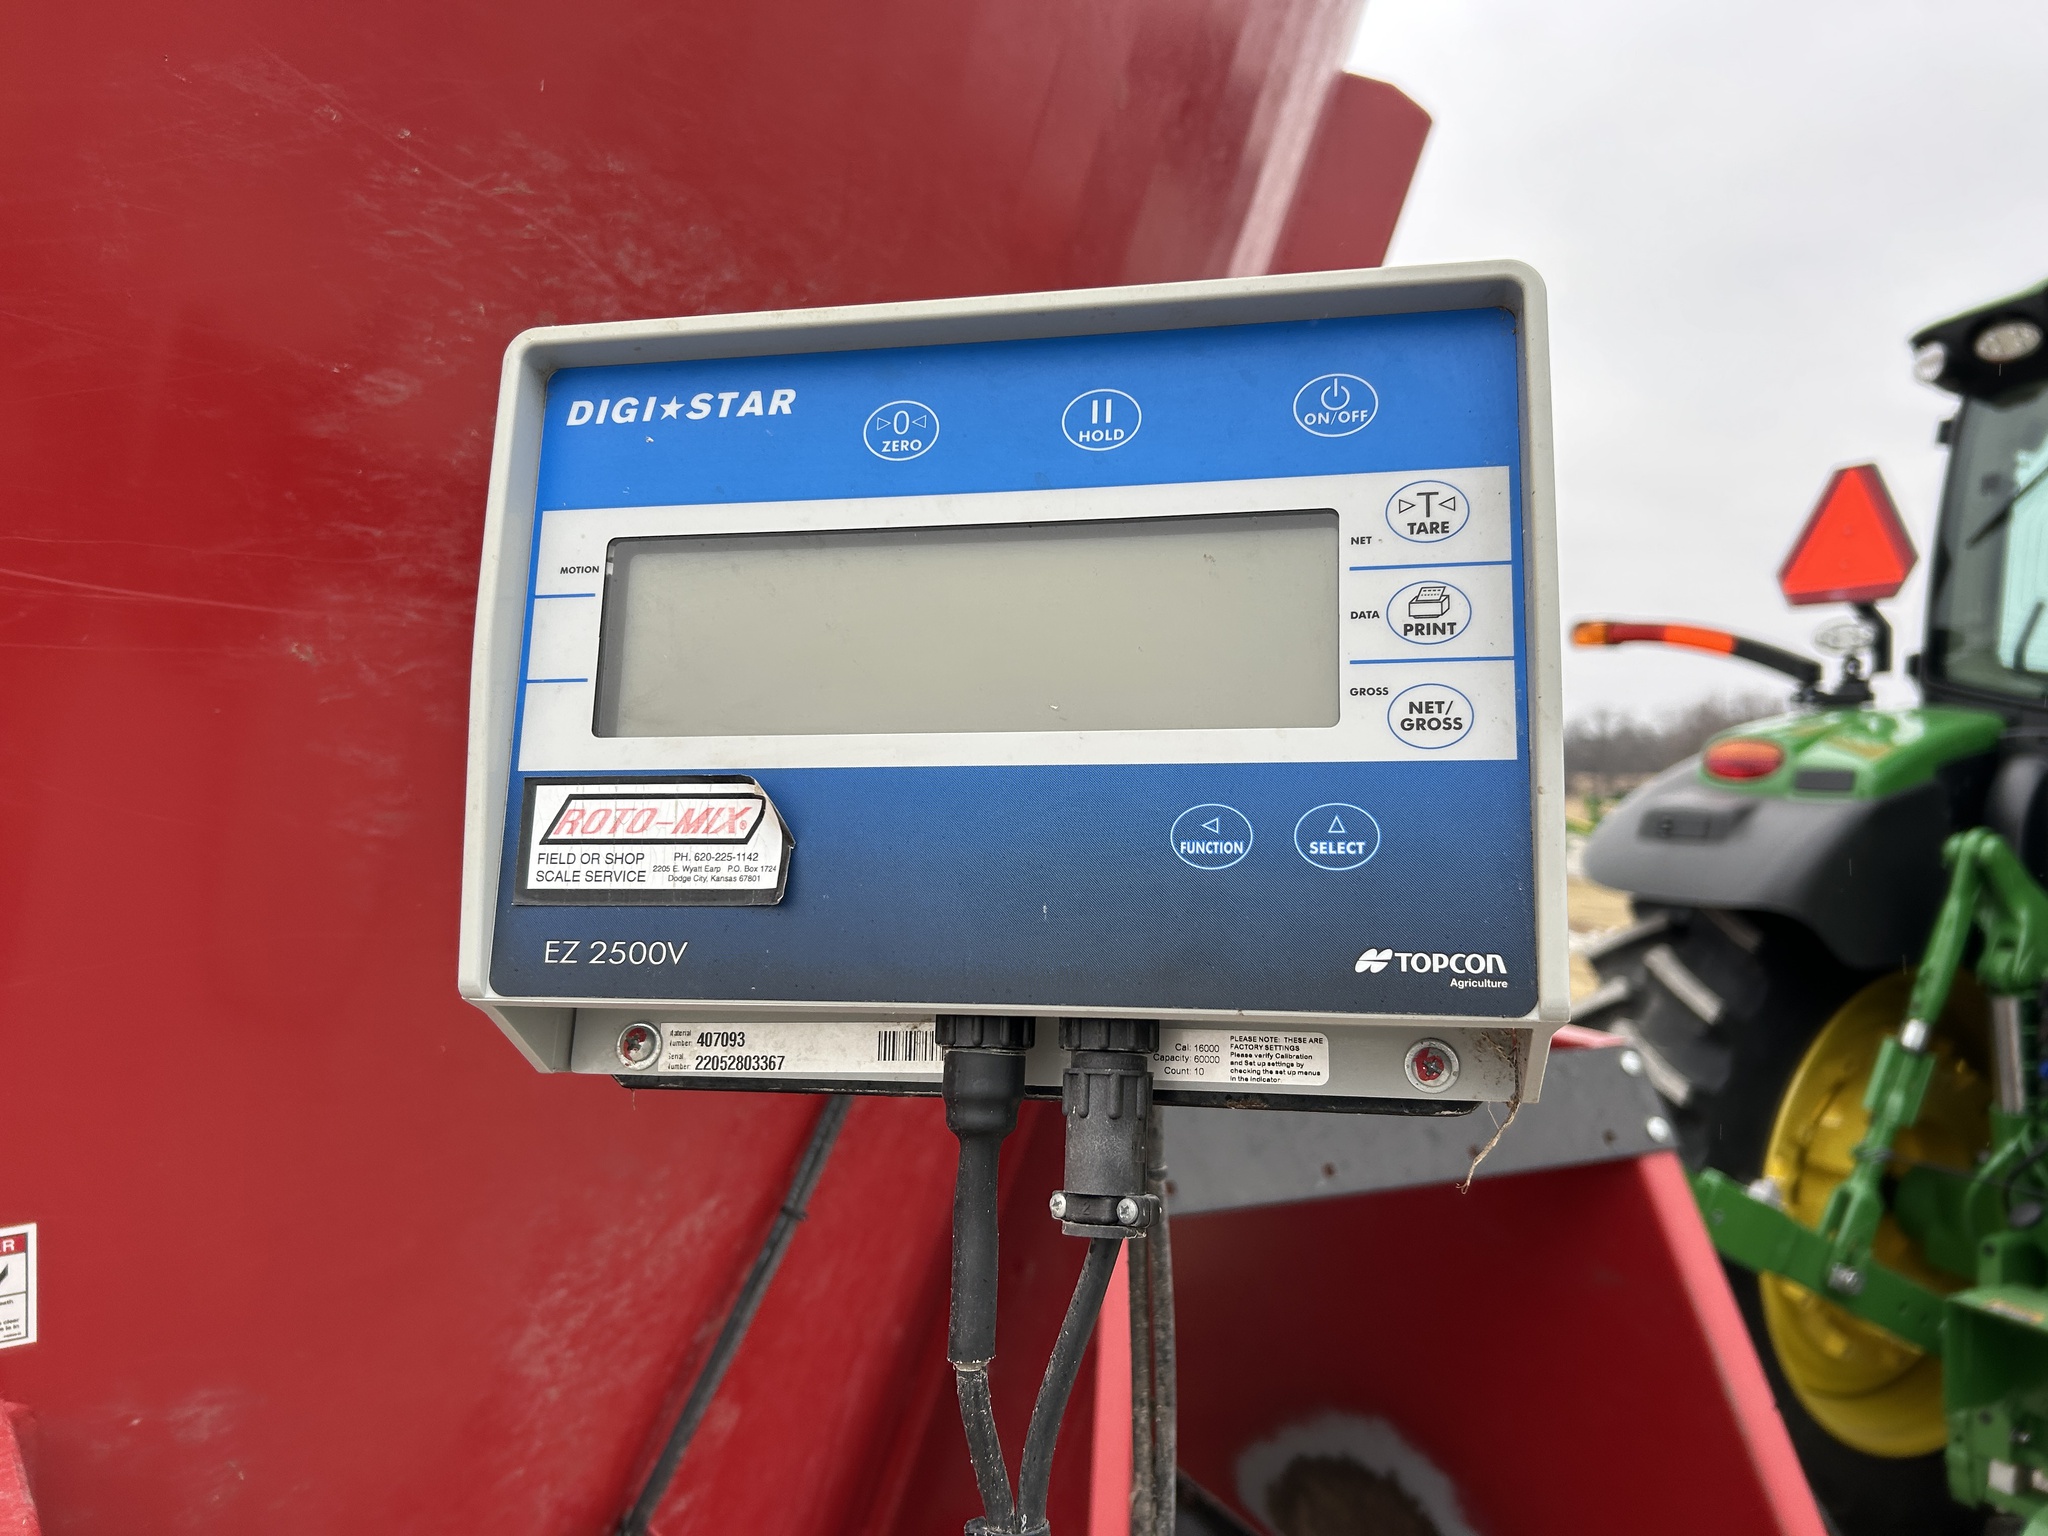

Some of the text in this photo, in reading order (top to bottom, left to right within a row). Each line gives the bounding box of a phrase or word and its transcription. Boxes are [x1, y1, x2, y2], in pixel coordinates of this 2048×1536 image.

[1304, 409, 1368, 426] ON/OFF
[1078, 428, 1125, 443] HOLD
[881, 439, 922, 453] ZERO
[1407, 521, 1450, 535] TARE
[1350, 536, 1372, 545] NET
[560, 565, 600, 575] MOTION
[1350, 610, 1380, 620] DATA
[1403, 622, 1457, 637] PRINT
[1350, 687, 1389, 696] GROSS
[1408, 700, 1454, 716] NET/
[1400, 717, 1463, 731] GROSS
[1180, 841, 1243, 855] FUNCTION
[1309, 841, 1366, 855] SELECT
[537, 852, 645, 865] FIELD OR SHOP
[674, 852, 759, 862] PH. 620-225-1142
[682, 865, 702, 874] Wyatt
[704, 865, 721, 874] Earp
[535, 870, 646, 883] SCALE SERVICE
[668, 875, 691, 883] Dodge
[693, 875, 708, 883] City,
[544, 940, 689, 965] EZ 2500V
[1394, 952, 1508, 974] TOPCON
[1450, 978, 1508, 989] Agriculture
[697, 1031, 746, 1047] 407093
[1230, 1035, 1258, 1043] PLEASE
[1174, 1043, 1220, 1053] Cal: 16000
[1230, 1043, 1264, 1051] FACTORY
[694, 1055, 786, 1071] 22052803367
[1153, 1053, 1220, 1064] Capacity: 60000
[1164, 1066, 1205, 1076] Count: 10
[1267, 1061, 1295, 1069] settings
[1296, 1061, 1304, 1069] by
[1230, 1068, 1261, 1076] checking
